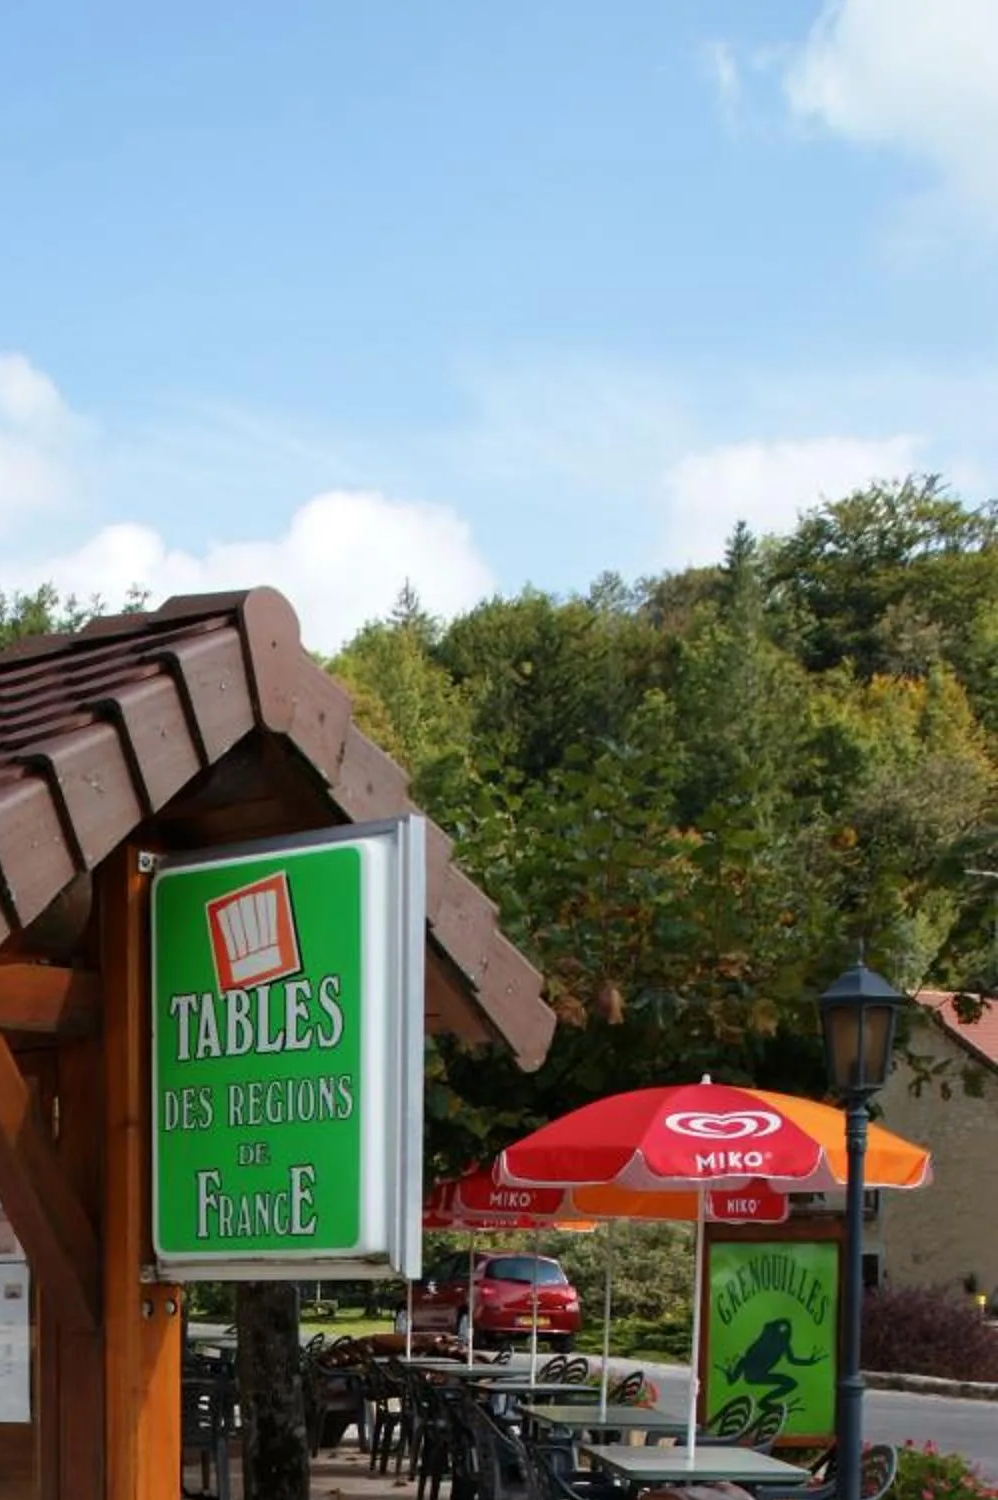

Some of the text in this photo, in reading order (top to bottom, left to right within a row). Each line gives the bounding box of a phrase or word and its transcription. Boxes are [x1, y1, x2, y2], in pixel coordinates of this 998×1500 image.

[169, 974, 345, 1061] TABLES
[163, 1074, 354, 1132] DES REGIONS
[238, 1142, 270, 1167] DE
[695, 1151, 763, 1173] MIKO
[196, 1164, 318, 1239] FRANCE
[489, 1191, 531, 1207] MIKO
[716, 1253, 830, 1327] GRENOUILLES
